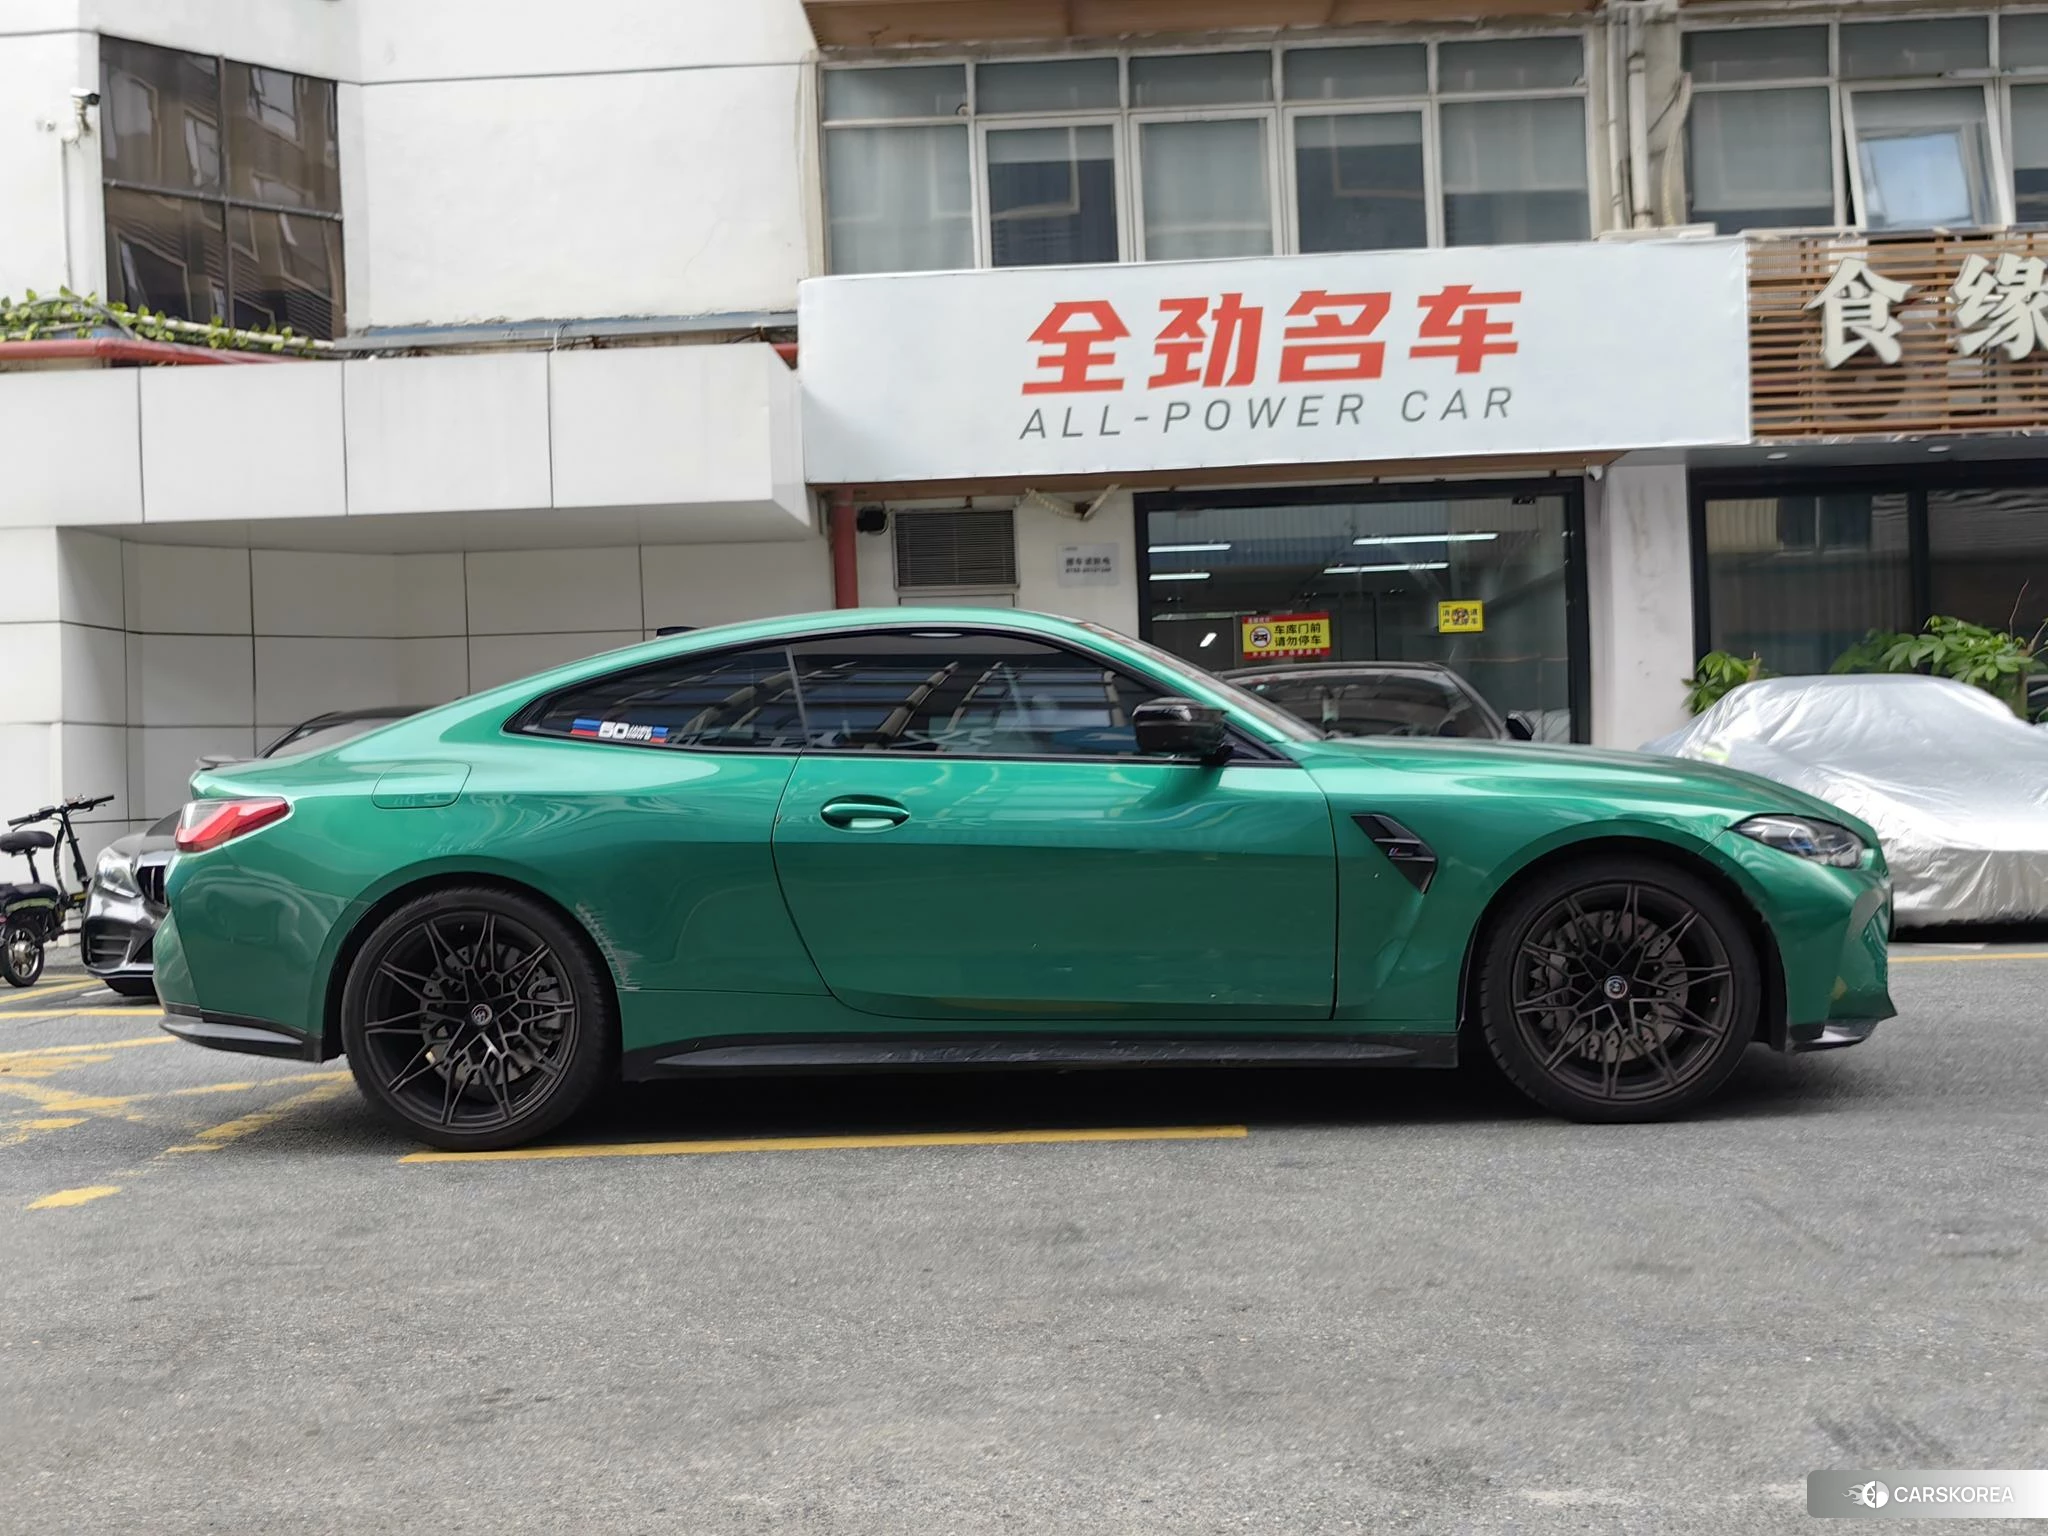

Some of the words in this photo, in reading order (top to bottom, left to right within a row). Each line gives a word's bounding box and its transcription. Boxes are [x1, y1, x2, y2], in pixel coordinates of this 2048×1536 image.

[1802, 253, 2048, 370] 食缘
[1022, 285, 1522, 394] 全劲名车
[1019, 393, 1364, 440] ALL-POWER
[1401, 387, 1512, 423] CAR
[1274, 622, 1321, 635] 车库门前
[1275, 635, 1322, 647] 请勿停车
